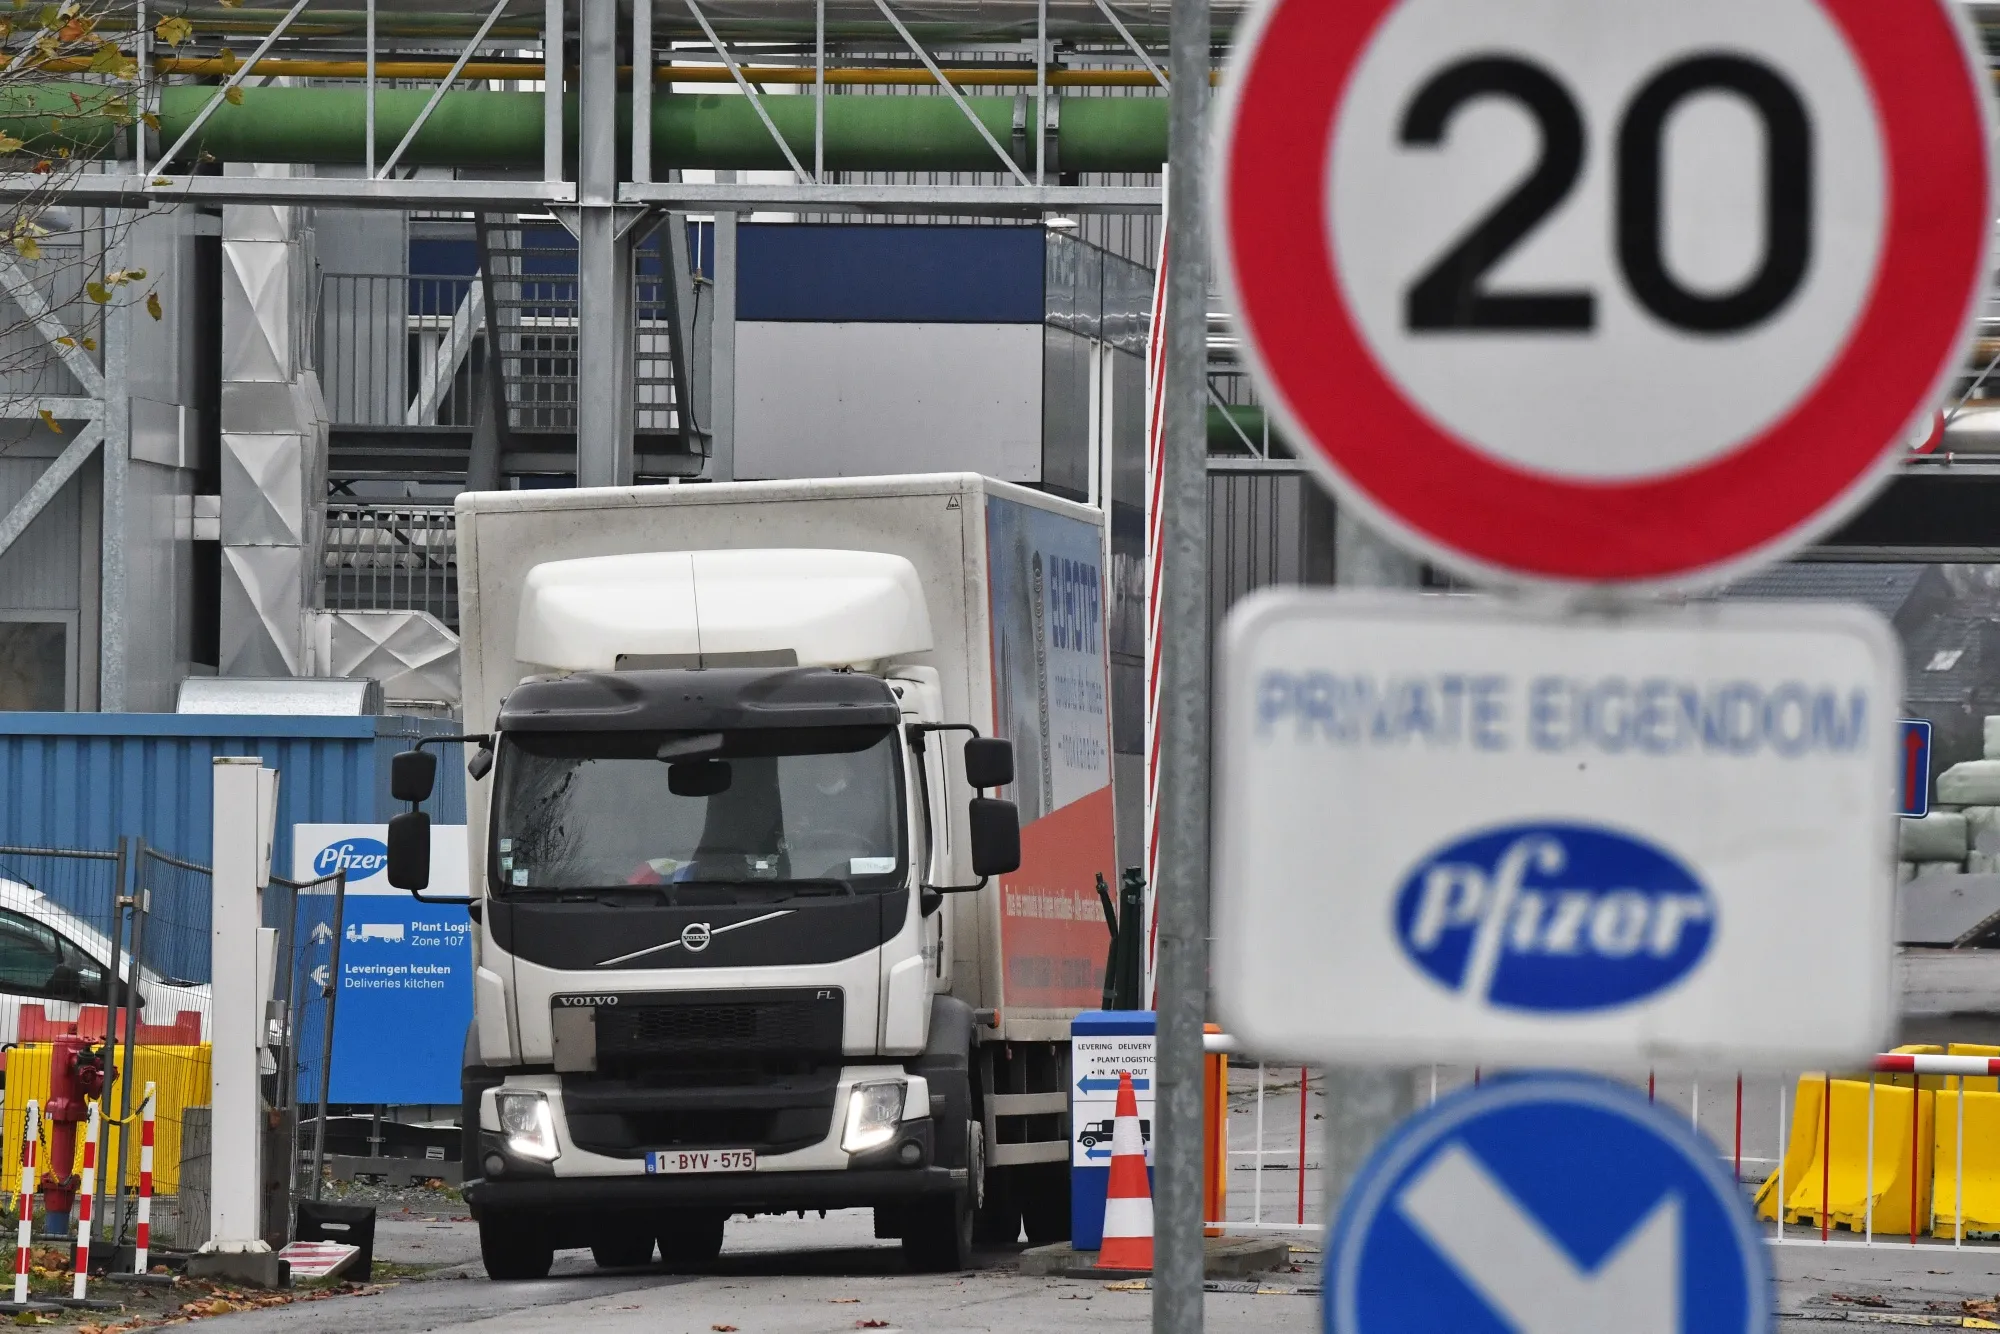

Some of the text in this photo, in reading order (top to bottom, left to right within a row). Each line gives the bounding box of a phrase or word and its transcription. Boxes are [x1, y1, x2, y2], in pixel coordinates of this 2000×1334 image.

[1397, 50, 1815, 339] 20
[1255, 670, 1870, 757] PRIVATE EIGENDOM
[320, 845, 388, 873] Pfizer
[1410, 835, 1711, 1000] Pfizer
[411, 921, 442, 932] Plant
[411, 935, 464, 946] Zone 107
[345, 963, 451, 976] Leveringen keuken
[345, 977, 445, 989] Deliveries kitchen
[559, 995, 619, 1006] VOLVO
[816, 990, 836, 1000] FL
[647, 1164, 655, 1172] B
